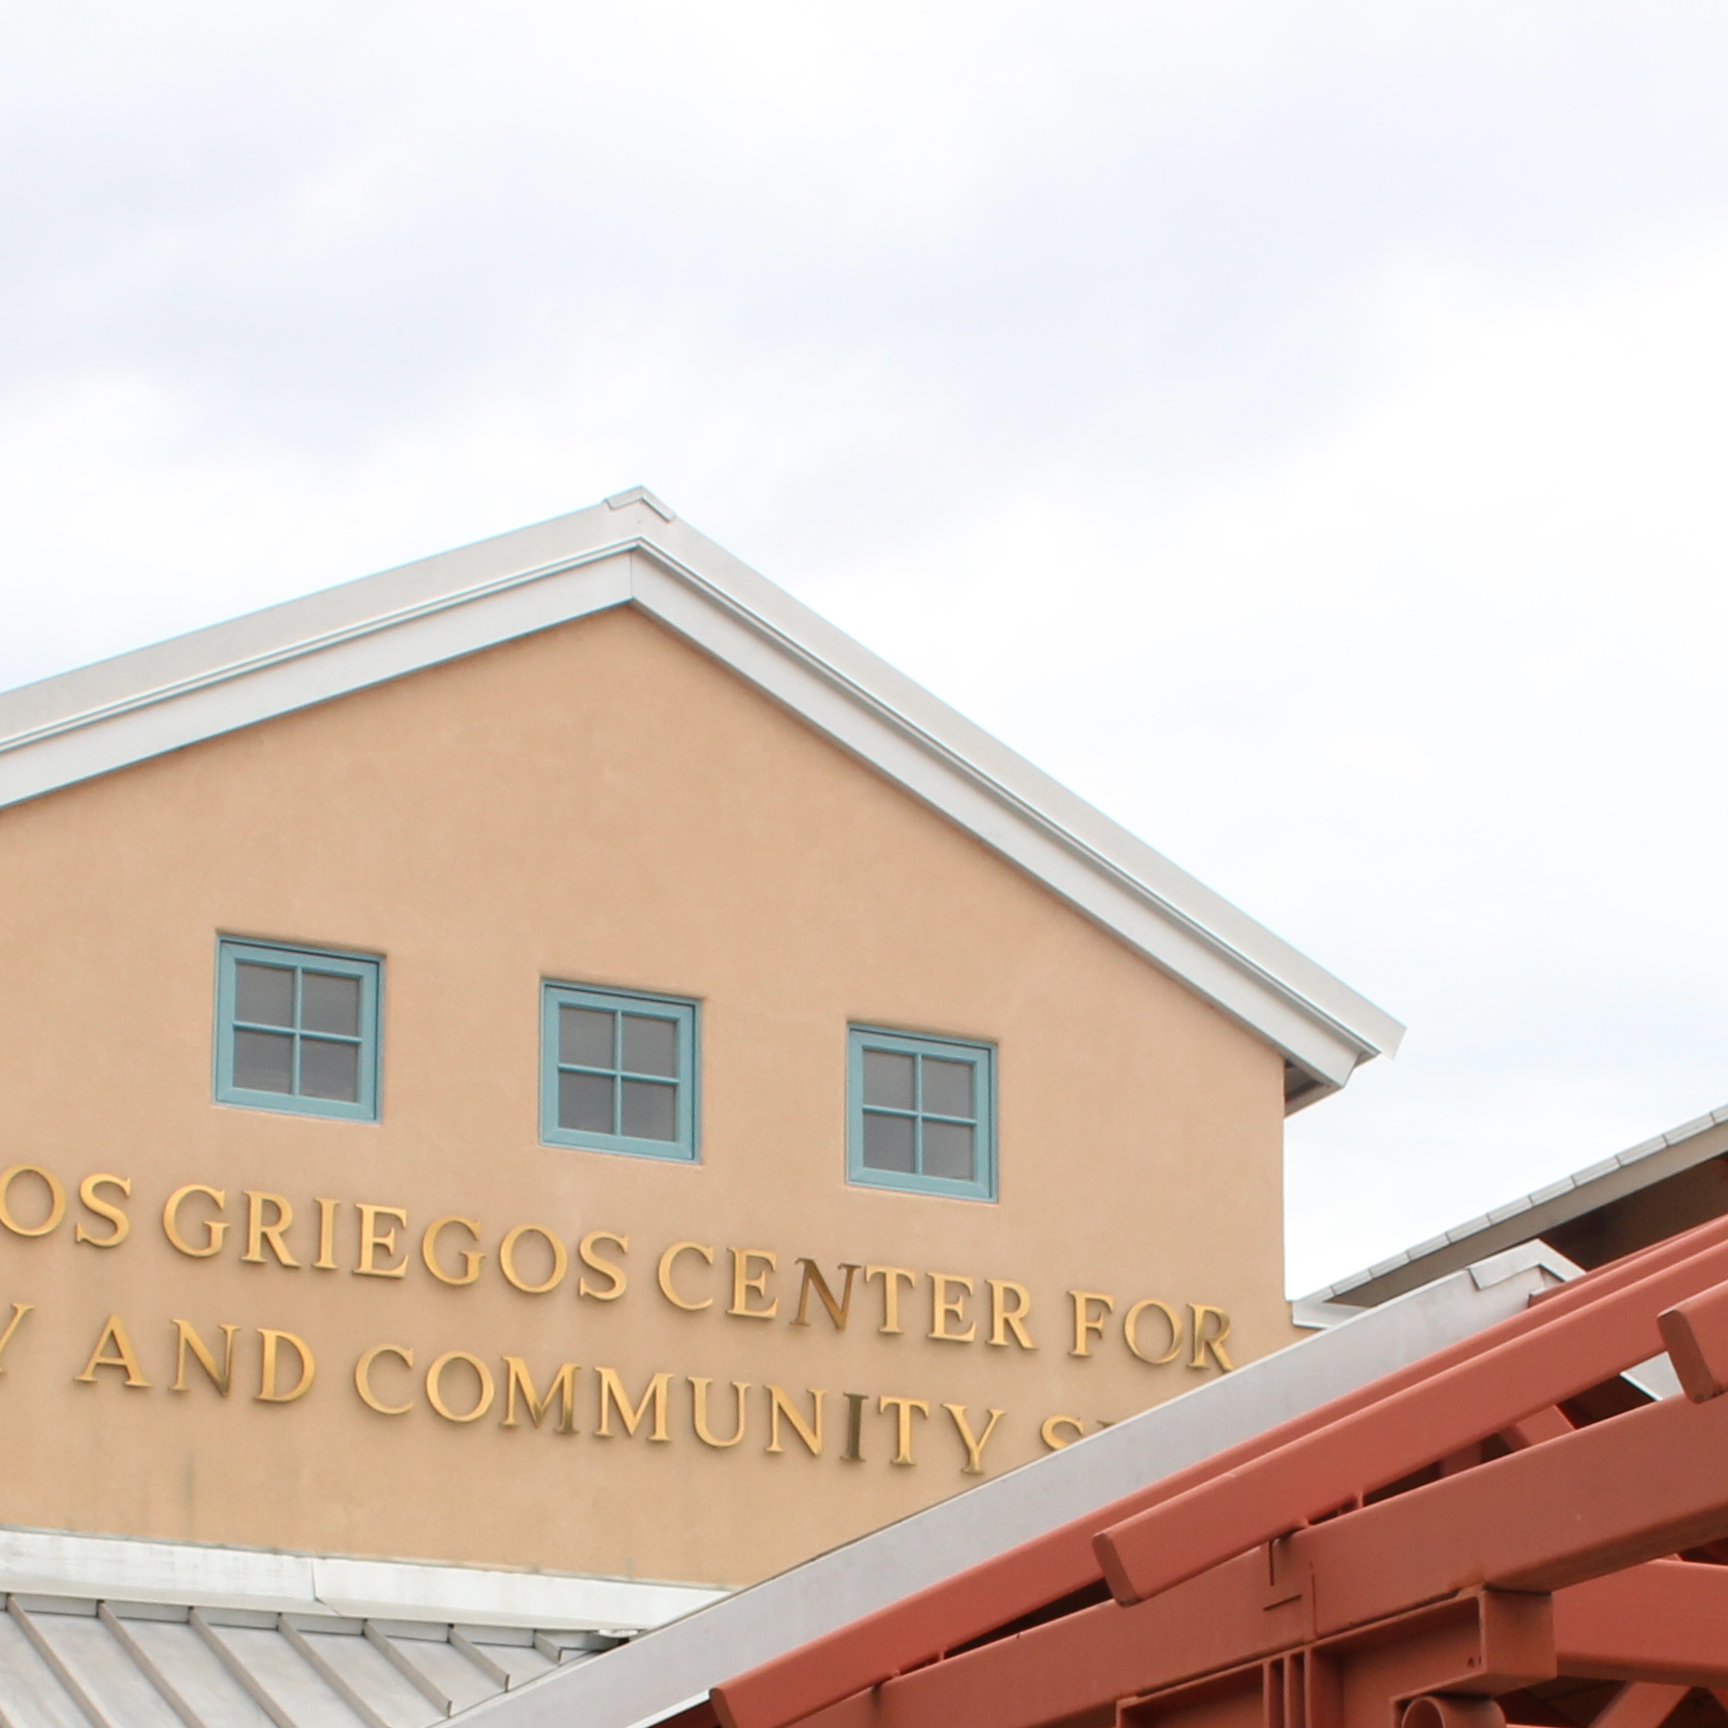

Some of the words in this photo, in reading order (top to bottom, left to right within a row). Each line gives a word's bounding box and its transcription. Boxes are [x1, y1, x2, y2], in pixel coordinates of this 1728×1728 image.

[162, 1182, 629, 1302] GRIEGOS
[658, 1240, 1038, 1352] CENTER
[1067, 1289, 1235, 1373] FOR
[76, 1313, 318, 1405] AND
[354, 1343, 1006, 1475] COMMUNITY
